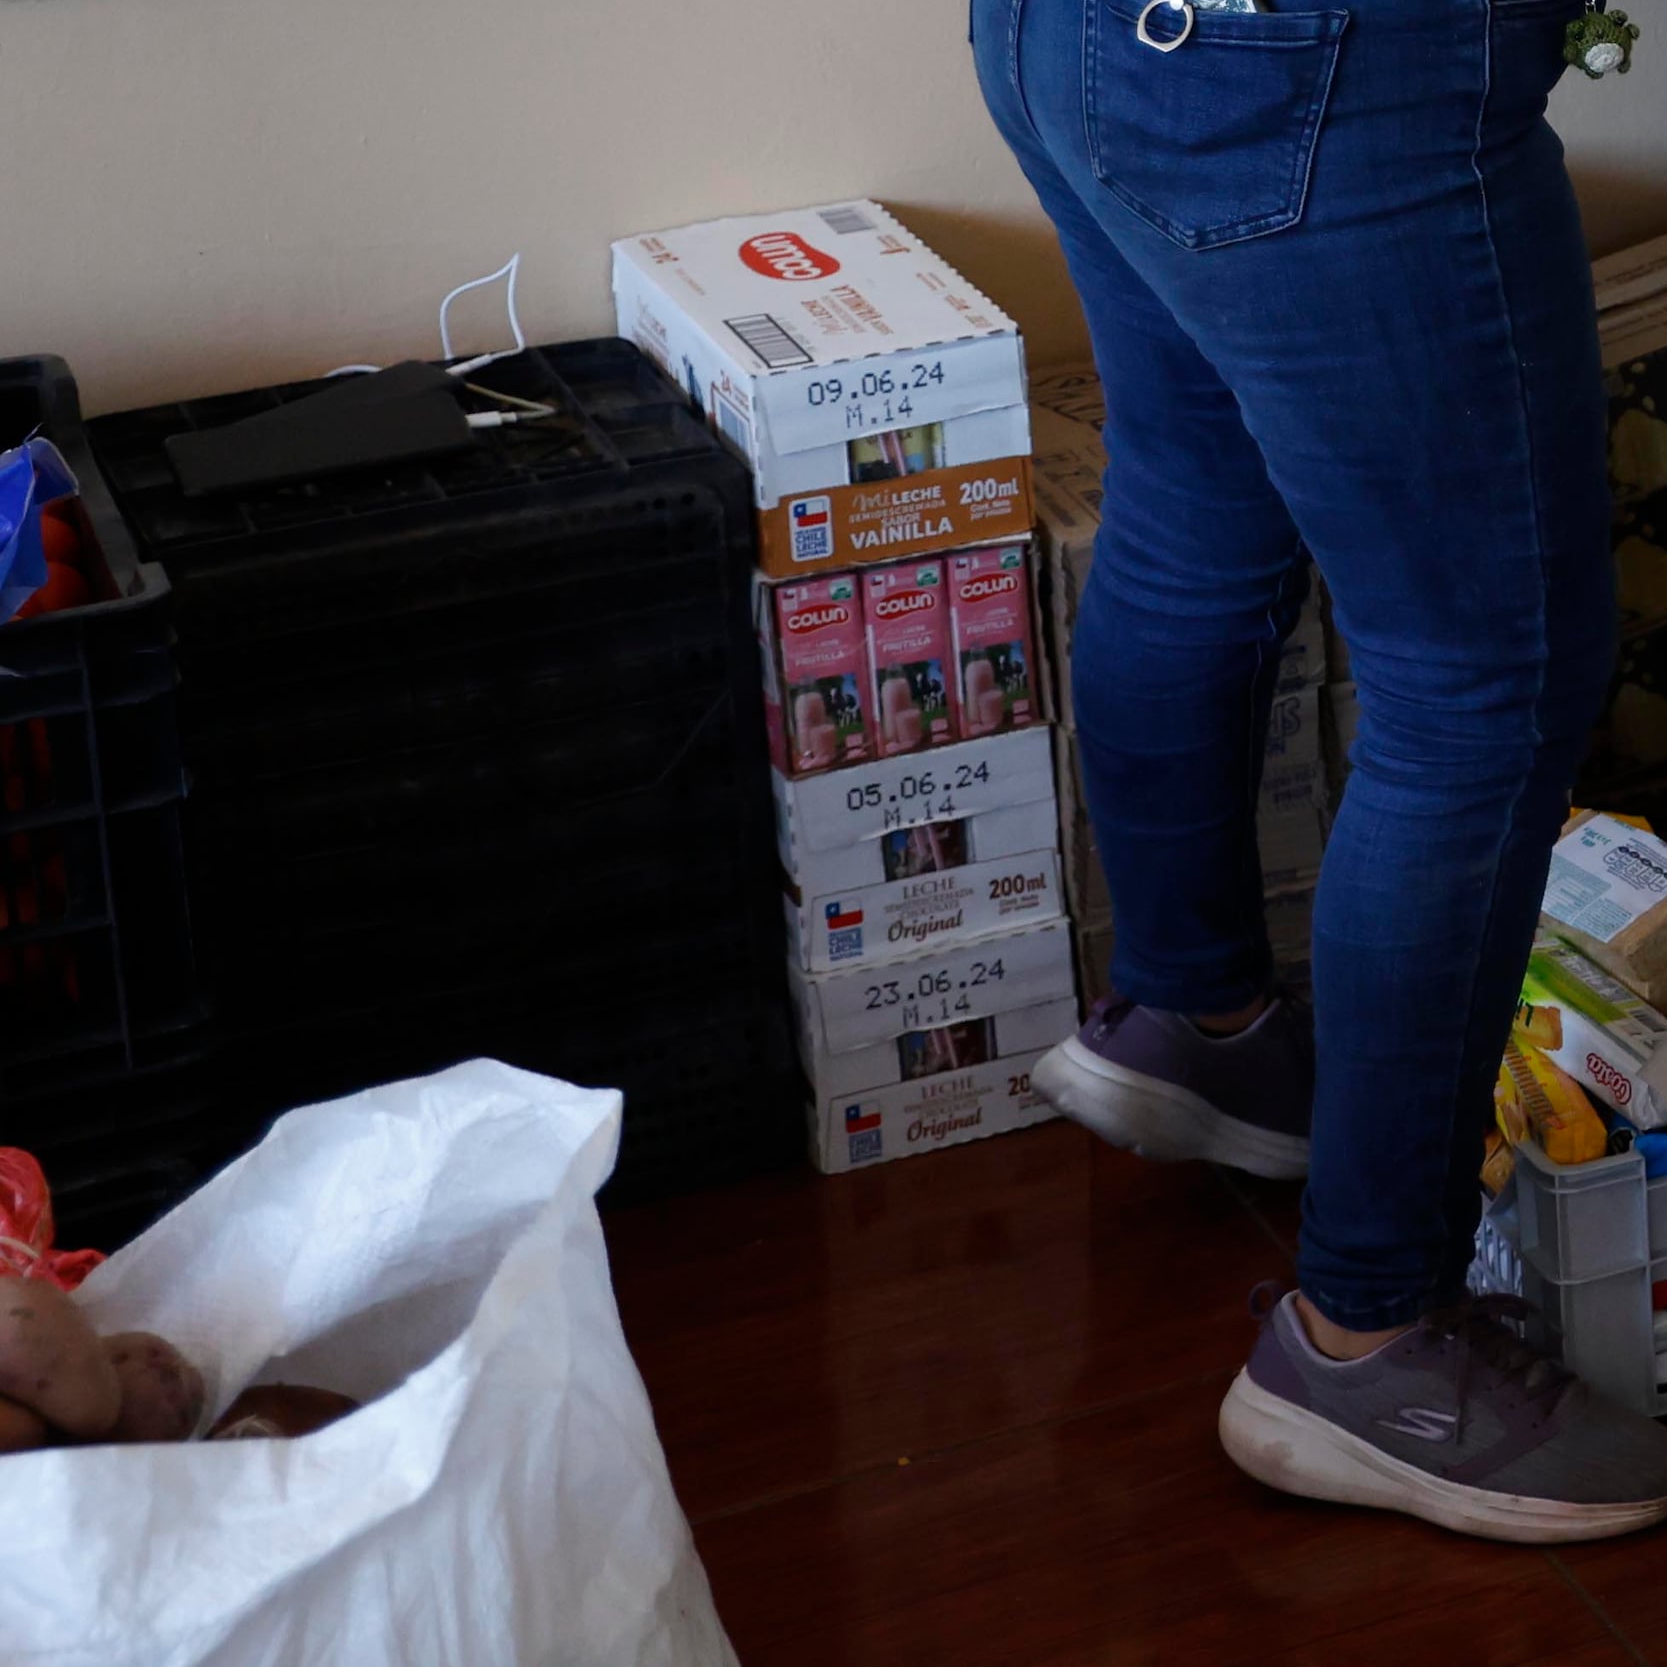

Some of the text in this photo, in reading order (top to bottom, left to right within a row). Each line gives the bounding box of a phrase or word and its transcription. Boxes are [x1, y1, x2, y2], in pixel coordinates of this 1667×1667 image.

[807, 362, 945, 406] 09.06.24
[845, 400, 913, 429] M.14
[892, 486, 941, 506] LECHE
[960, 478, 1019, 505] 200ml
[850, 517, 954, 550] VAINILLA
[882, 513, 921, 528] SABOR
[959, 574, 1016, 599] COLUN
[787, 604, 848, 631] COLUN
[875, 592, 935, 617] COLUN
[846, 760, 991, 811] 05.06.24
[884, 798, 957, 829] M.14
[903, 876, 956, 899] LECHE
[887, 910, 964, 943] Original
[865, 958, 1005, 1010] 23.06.24
[903, 994, 970, 1028] M.14
[921, 1076, 975, 1100] LECHE
[1586, 1050, 1635, 1107] Costa
[906, 1107, 983, 1142] Original
